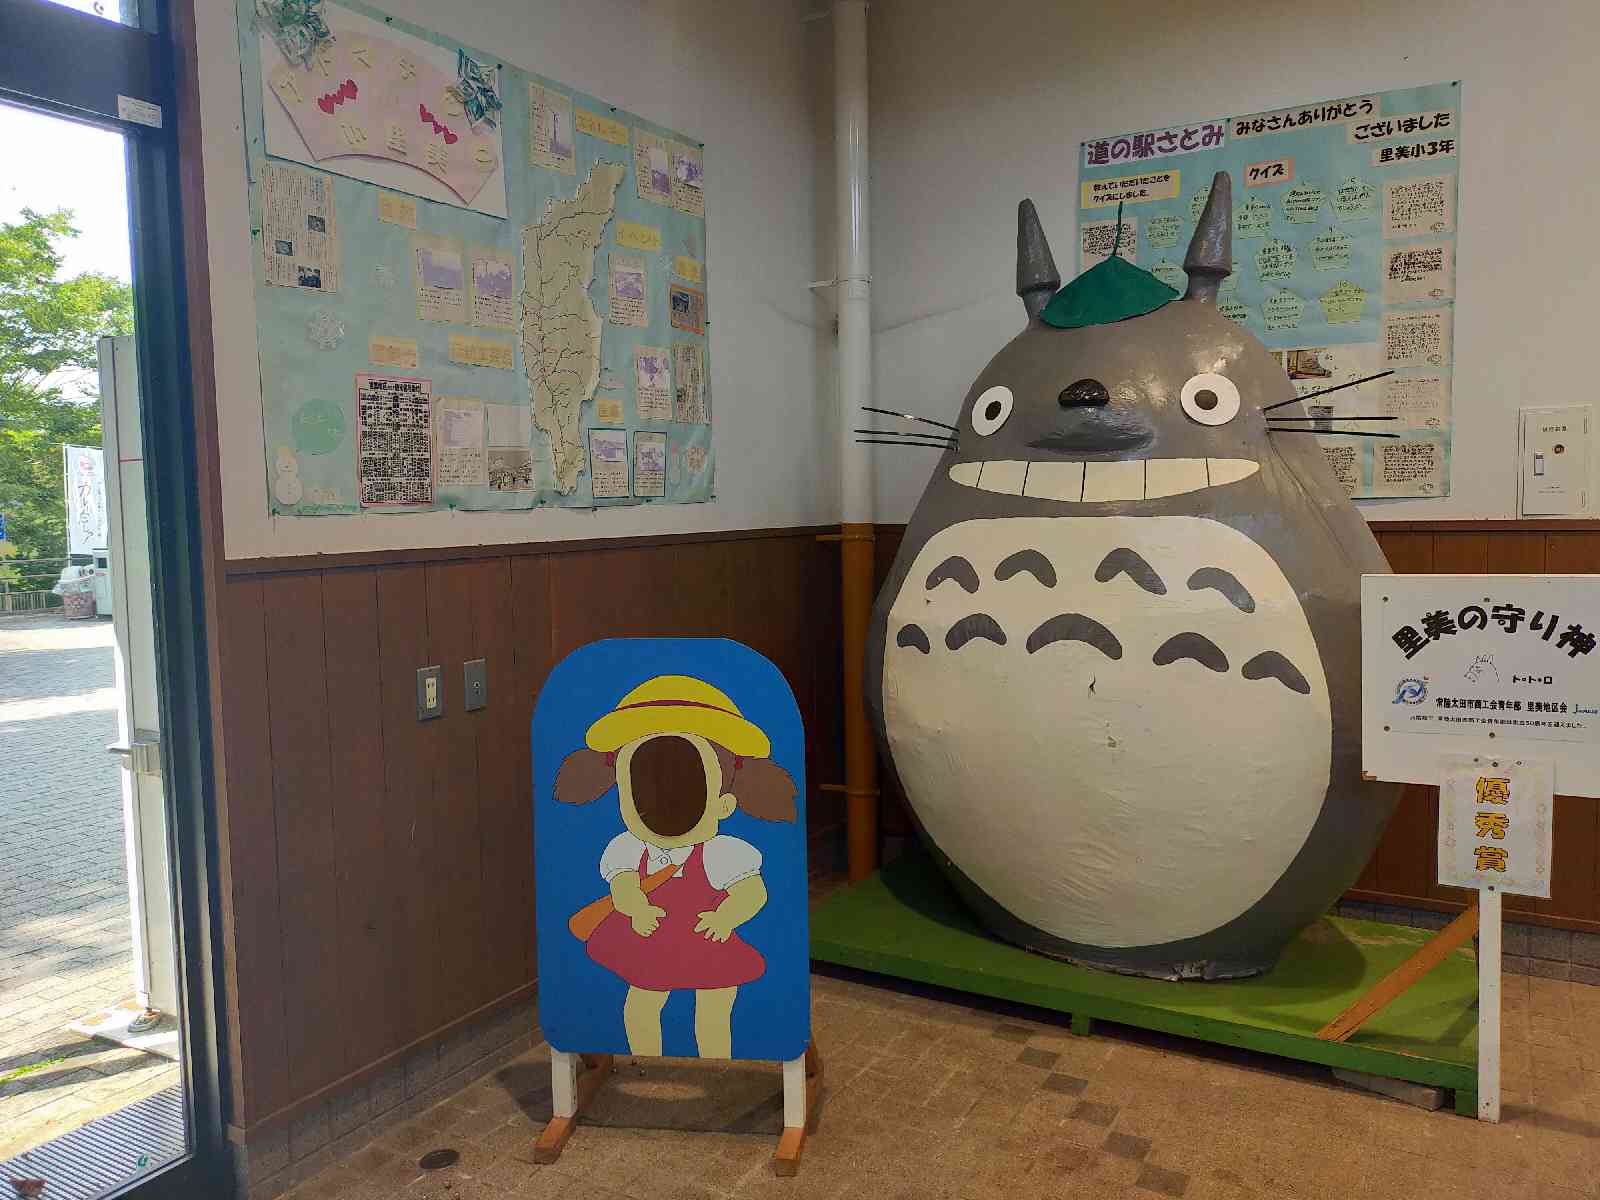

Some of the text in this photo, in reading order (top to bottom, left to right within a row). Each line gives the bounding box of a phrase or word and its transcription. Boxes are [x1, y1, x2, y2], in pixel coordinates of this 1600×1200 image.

[1234, 99, 1374, 136] みなさんありがとう
[1354, 112, 1451, 140] ございました
[1087, 123, 1225, 165] 道の駅さとみ
[1248, 161, 1286, 180] クイズ
[1391, 603, 1598, 660] 里美の守り神
[1526, 701, 1568, 714] 里美地区会
[1474, 776, 1511, 873] 優秀賞
